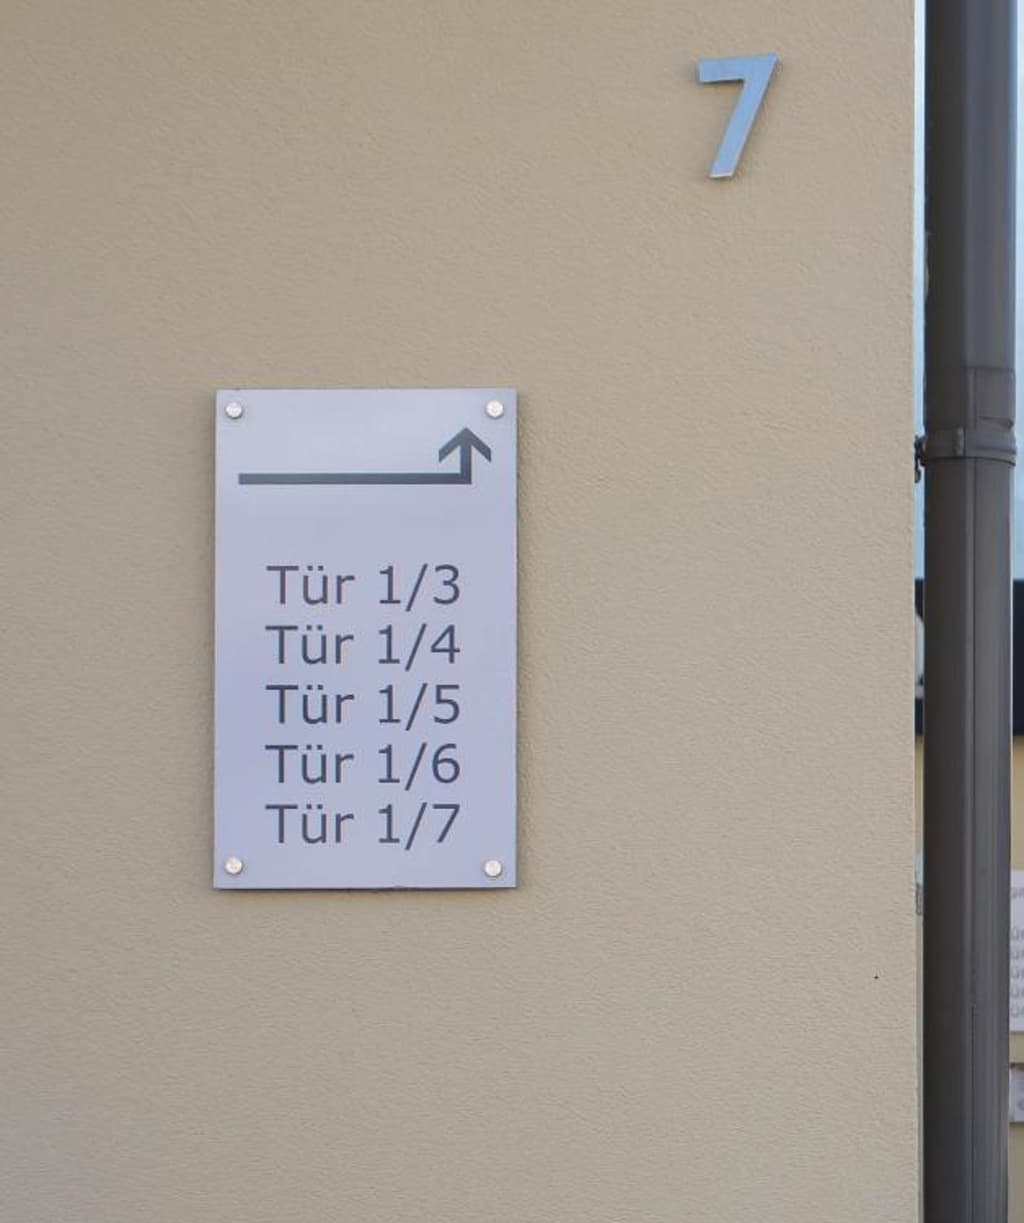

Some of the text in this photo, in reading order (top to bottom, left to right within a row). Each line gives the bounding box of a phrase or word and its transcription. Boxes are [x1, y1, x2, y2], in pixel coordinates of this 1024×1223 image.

[697, 52, 779, 178] 7
[266, 563, 461, 612] Tür 1/3
[265, 623, 461, 672] Tür 1/4
[265, 682, 461, 732] Tür 1/5
[265, 742, 461, 791] Tür 1/6
[265, 801, 461, 851] Tür 1/7
